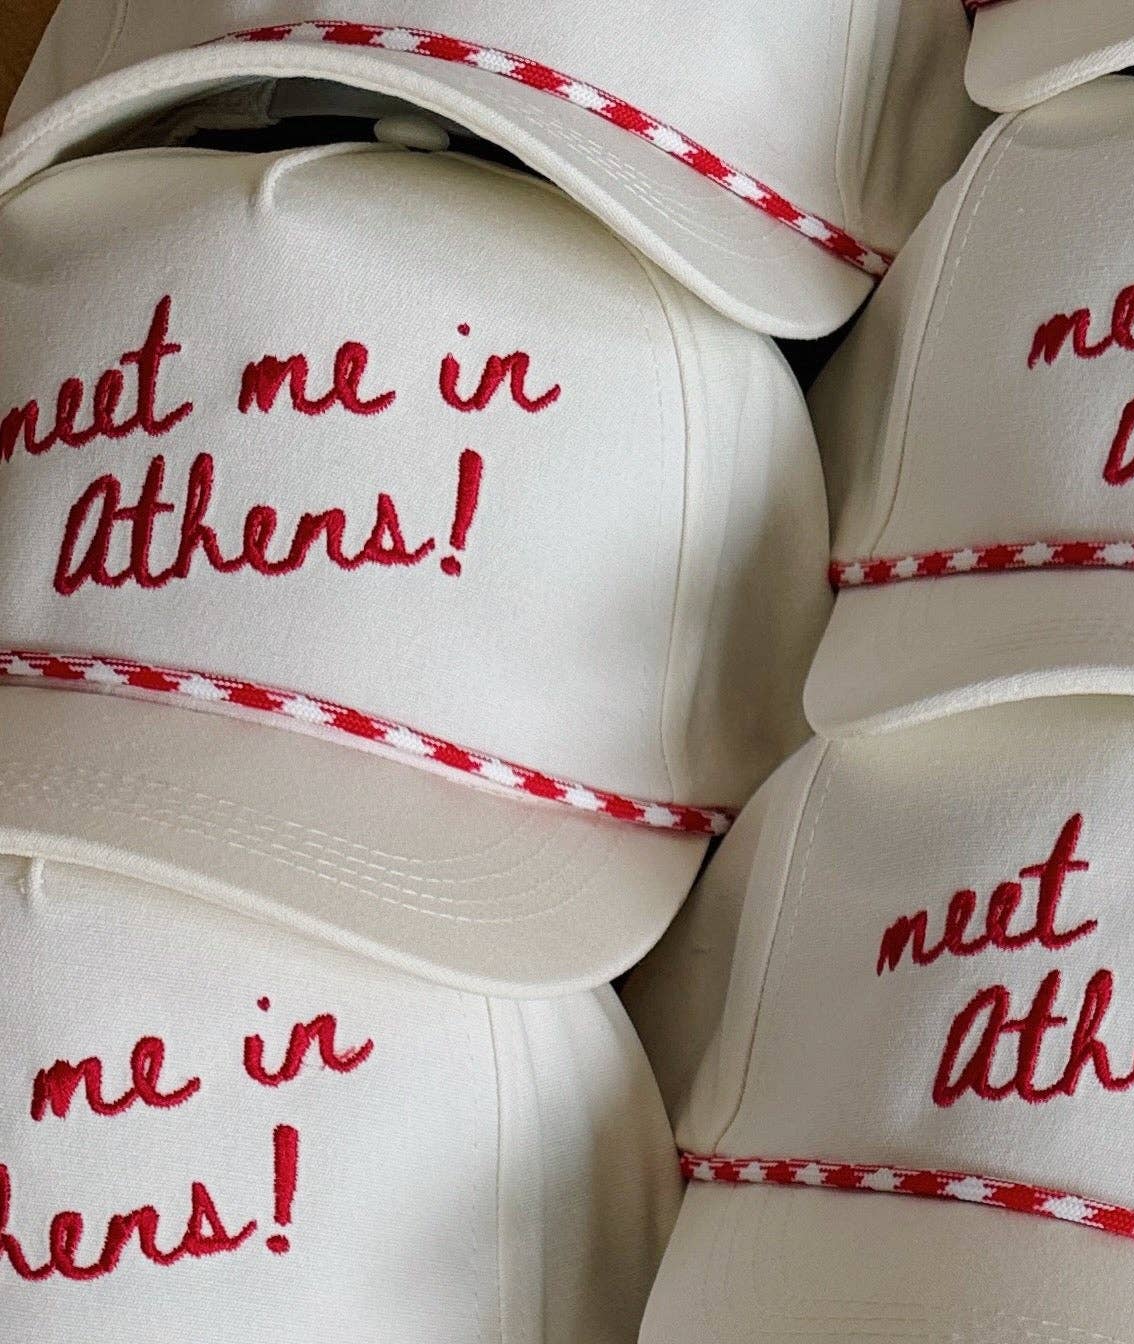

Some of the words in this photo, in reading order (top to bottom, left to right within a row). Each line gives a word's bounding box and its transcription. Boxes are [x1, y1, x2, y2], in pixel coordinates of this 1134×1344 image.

[240, 341, 395, 416] me
[439, 323, 560, 412] in
[54, 450, 483, 596] Athens!
[877, 814, 1097, 974] meet
[32, 1037, 200, 1121] me
[244, 997, 373, 1087] in
